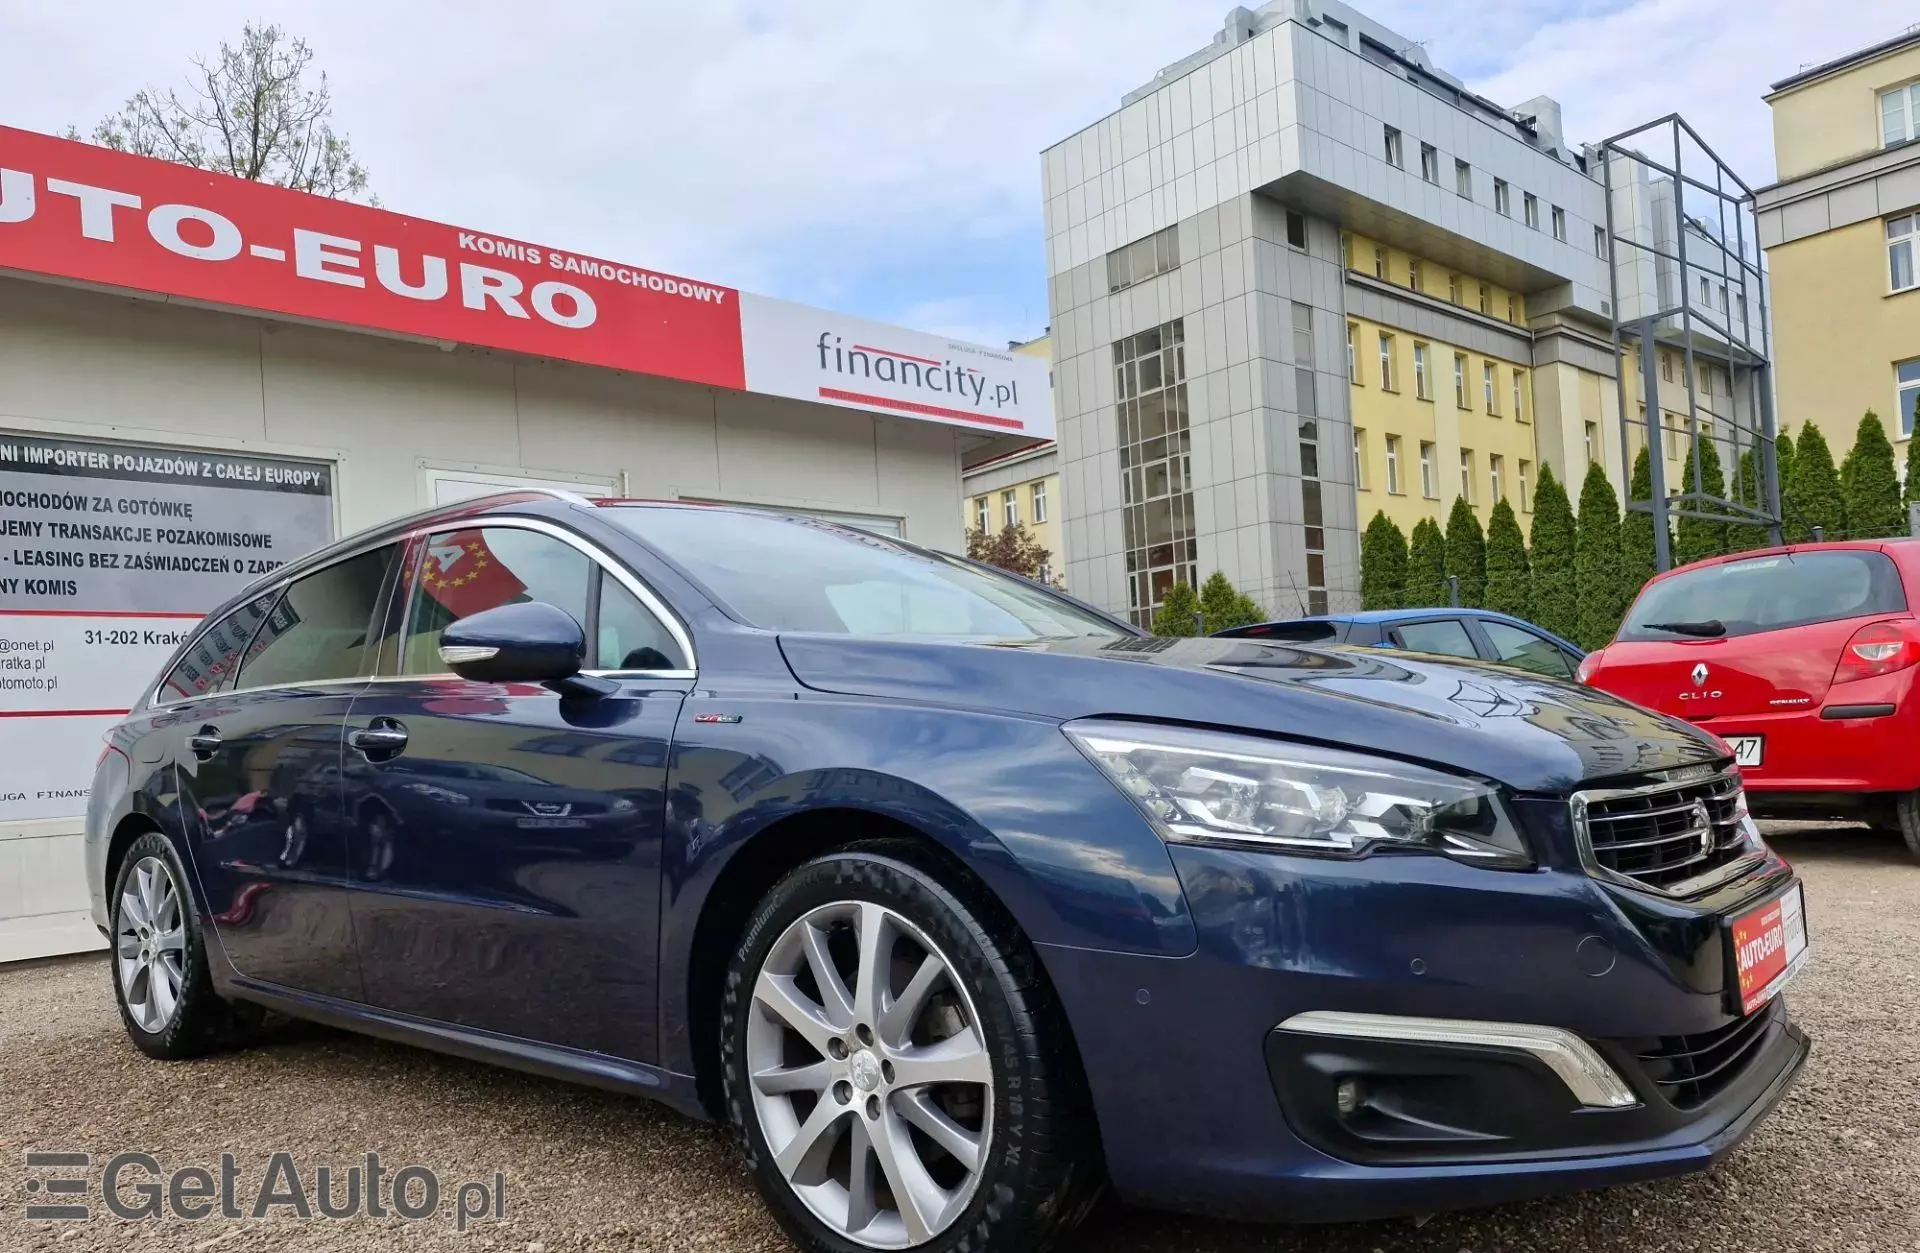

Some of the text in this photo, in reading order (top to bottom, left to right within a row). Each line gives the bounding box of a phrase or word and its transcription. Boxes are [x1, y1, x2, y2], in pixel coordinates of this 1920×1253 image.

[459, 232, 725, 304] KOMIS SAMOCHODOWY
[817, 332, 1018, 408] financity.pl
[24, 446, 109, 469] IMPORTER
[113, 454, 198, 476] POJAZDÓW
[202, 462, 212, 478] Z
[216, 463, 261, 482] CAŁEJ
[265, 467, 321, 486] EUROPY
[0, 490, 193, 522] OCHODÓW ZA GOTÓWKĘ
[48, 522, 152, 542] TRANSAKCJE
[157, 528, 272, 549] POZAKOMISOWE
[14, 550, 84, 567] LEASING
[89, 553, 119, 569] BEZ
[124, 552, 229, 573] ZAŚWIADCZEŃ
[234, 559, 244, 574] O
[25, 579, 77, 596] KOMIS
[85, 630, 138, 645] 31-202
[0, 676, 57, 692] tomoto.pl
[1679, 691, 1723, 700] CLIO
[1741, 924, 1783, 972] AUTO-EURO
